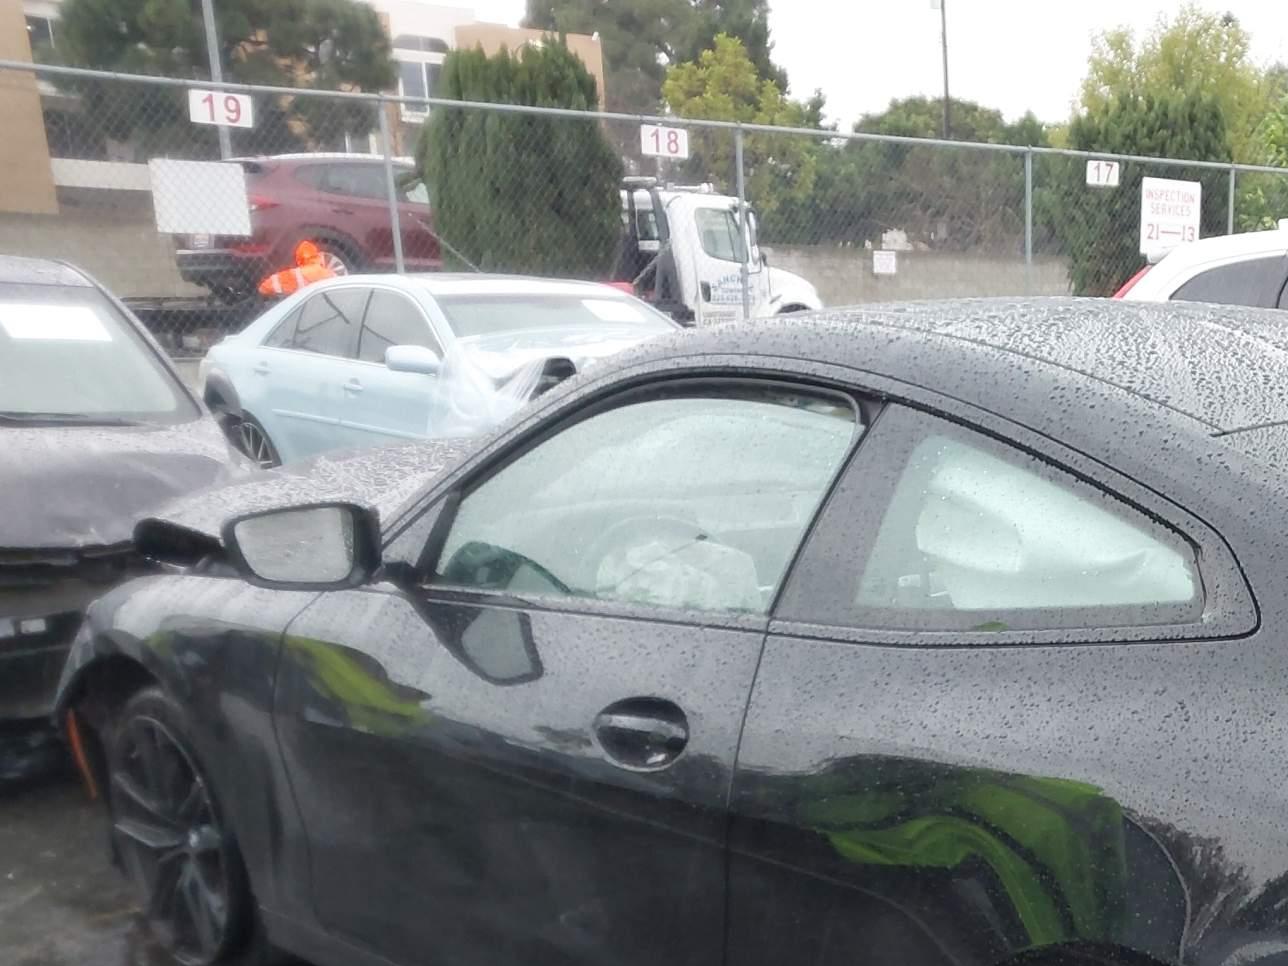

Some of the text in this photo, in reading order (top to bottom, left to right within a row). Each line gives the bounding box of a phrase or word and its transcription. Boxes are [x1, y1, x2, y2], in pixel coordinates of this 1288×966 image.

[202, 93, 241, 124] 19
[650, 128, 679, 154] 18
[1093, 162, 1114, 183] 17
[1145, 188, 1196, 203] INSPECTION
[1150, 202, 1192, 217] SERVICES
